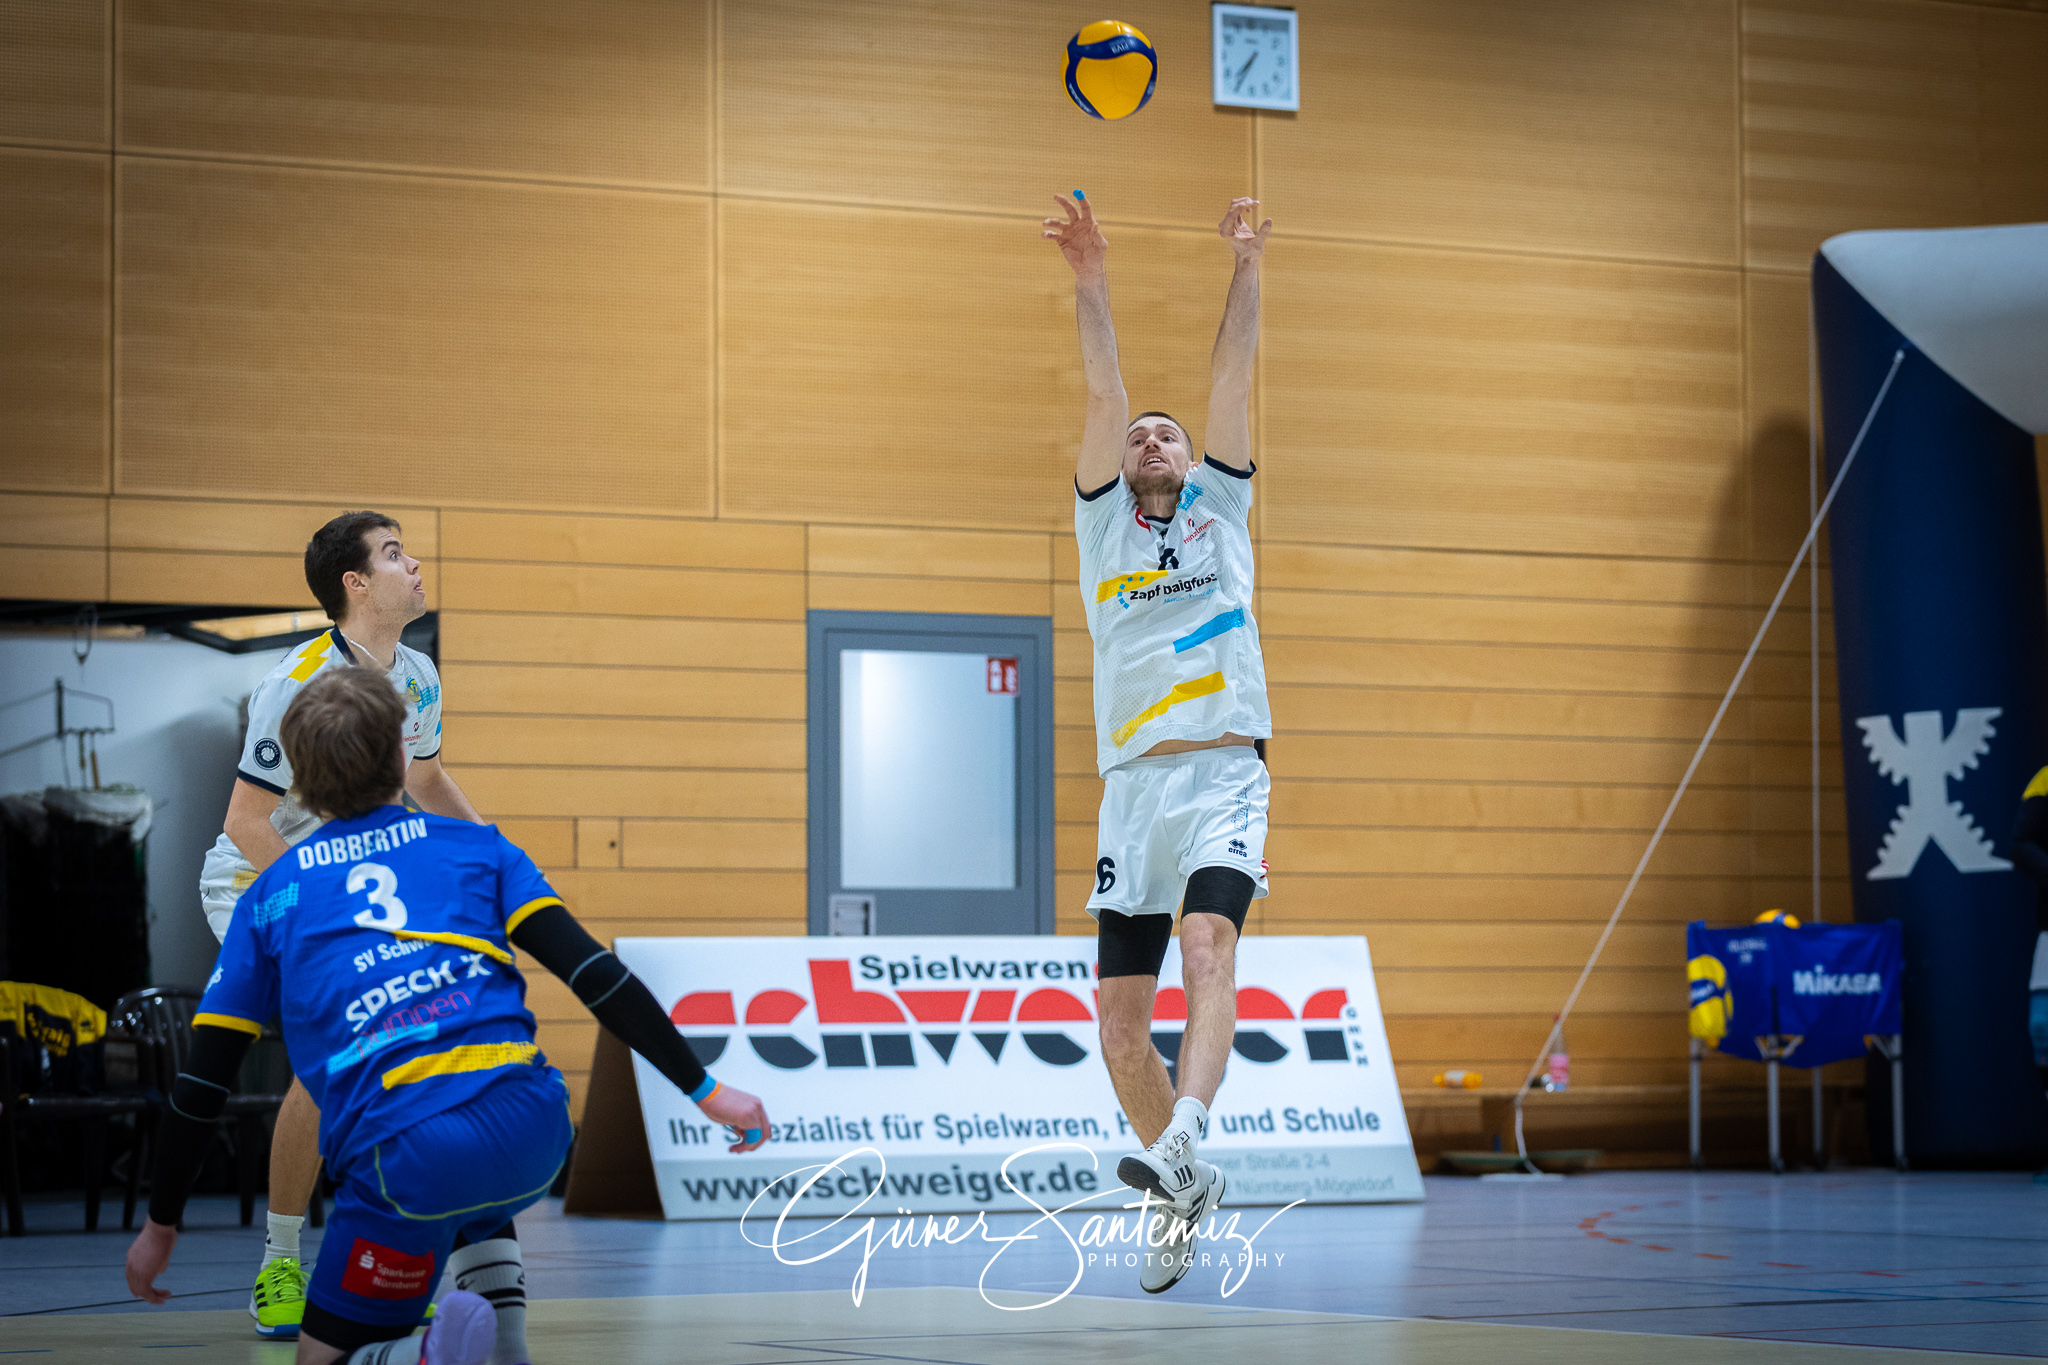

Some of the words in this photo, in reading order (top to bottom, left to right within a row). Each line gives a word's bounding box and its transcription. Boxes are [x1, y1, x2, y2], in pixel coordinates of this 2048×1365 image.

[1129, 585, 1161, 601] Zapf
[297, 818, 427, 870] DOBBERTIN
[1096, 856, 1116, 895] 6
[346, 862, 408, 931] 3
[353, 949, 376, 973] SV
[377, 939, 434, 960] Schw
[859, 955, 1088, 986] Spielwaren
[345, 960, 458, 1033] SPECK
[355, 990, 471, 1059] pumpen
[669, 959, 1349, 1089] schweer
[669, 1118, 711, 1145] Ihr
[725, 1116, 873, 1143] Sezialist
[882, 1113, 923, 1142] für
[934, 1112, 1109, 1144] Spielwaren,
[1221, 1108, 1275, 1134] und
[1282, 1106, 1381, 1133] Schule
[682, 1162, 1097, 1202] www.schweiger.de
